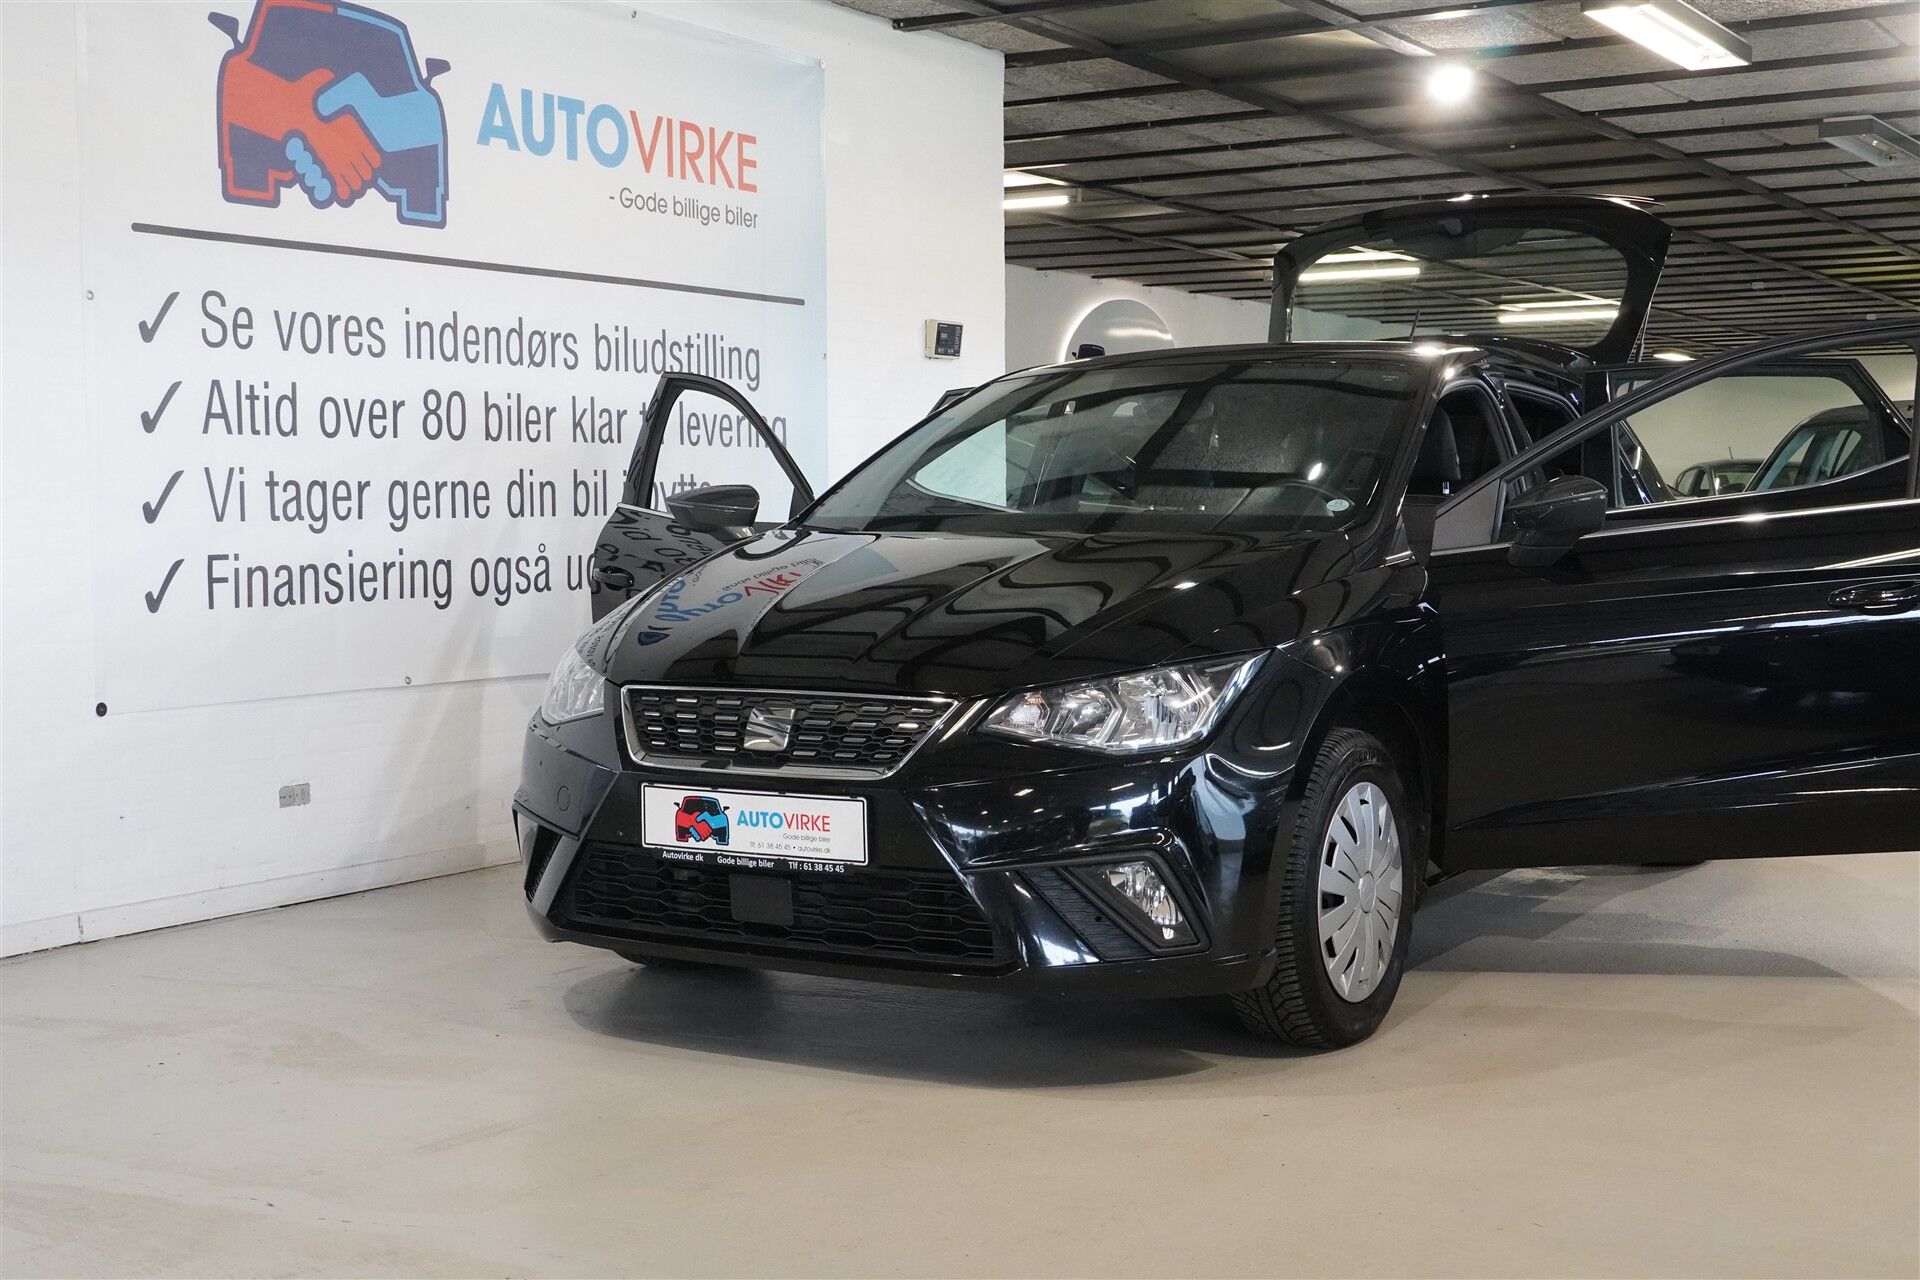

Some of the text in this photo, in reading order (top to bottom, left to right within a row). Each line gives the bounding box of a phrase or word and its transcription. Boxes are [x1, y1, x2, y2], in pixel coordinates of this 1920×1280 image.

[477, 83, 759, 193] AUTOVIRKE
[619, 188, 668, 214] Gode
[672, 196, 722, 226] billige
[724, 206, 759, 229] biler
[201, 289, 761, 392] Se vores indendørs biludstilling
[202, 379, 299, 439] Altid
[319, 396, 407, 440] over
[422, 388, 468, 443] 80
[484, 390, 558, 445] biler
[571, 395, 629, 445] klar
[204, 466, 248, 523] Vi
[265, 471, 373, 535] tager
[388, 479, 490, 533] gerne
[506, 468, 557, 518] din
[573, 468, 608, 518] bil
[207, 548, 454, 611] Finansiering
[470, 543, 552, 606] også
[737, 810, 831, 833] AUTOVIRKE
[757, 841, 765, 849] 61
[766, 842, 774, 850] 38
[775, 842, 783, 850] 45
[784, 843, 792, 851] 45
[782, 833, 800, 842] Gode
[662, 850, 694, 861] Autovirke
[695, 853, 704, 862] dk
[717, 856, 736, 865] Gode
[758, 859, 775, 869] biler
[803, 862, 813, 871] 61
[814, 863, 823, 871] 38
[824, 864, 834, 873] 45
[835, 865, 845, 874] 45
